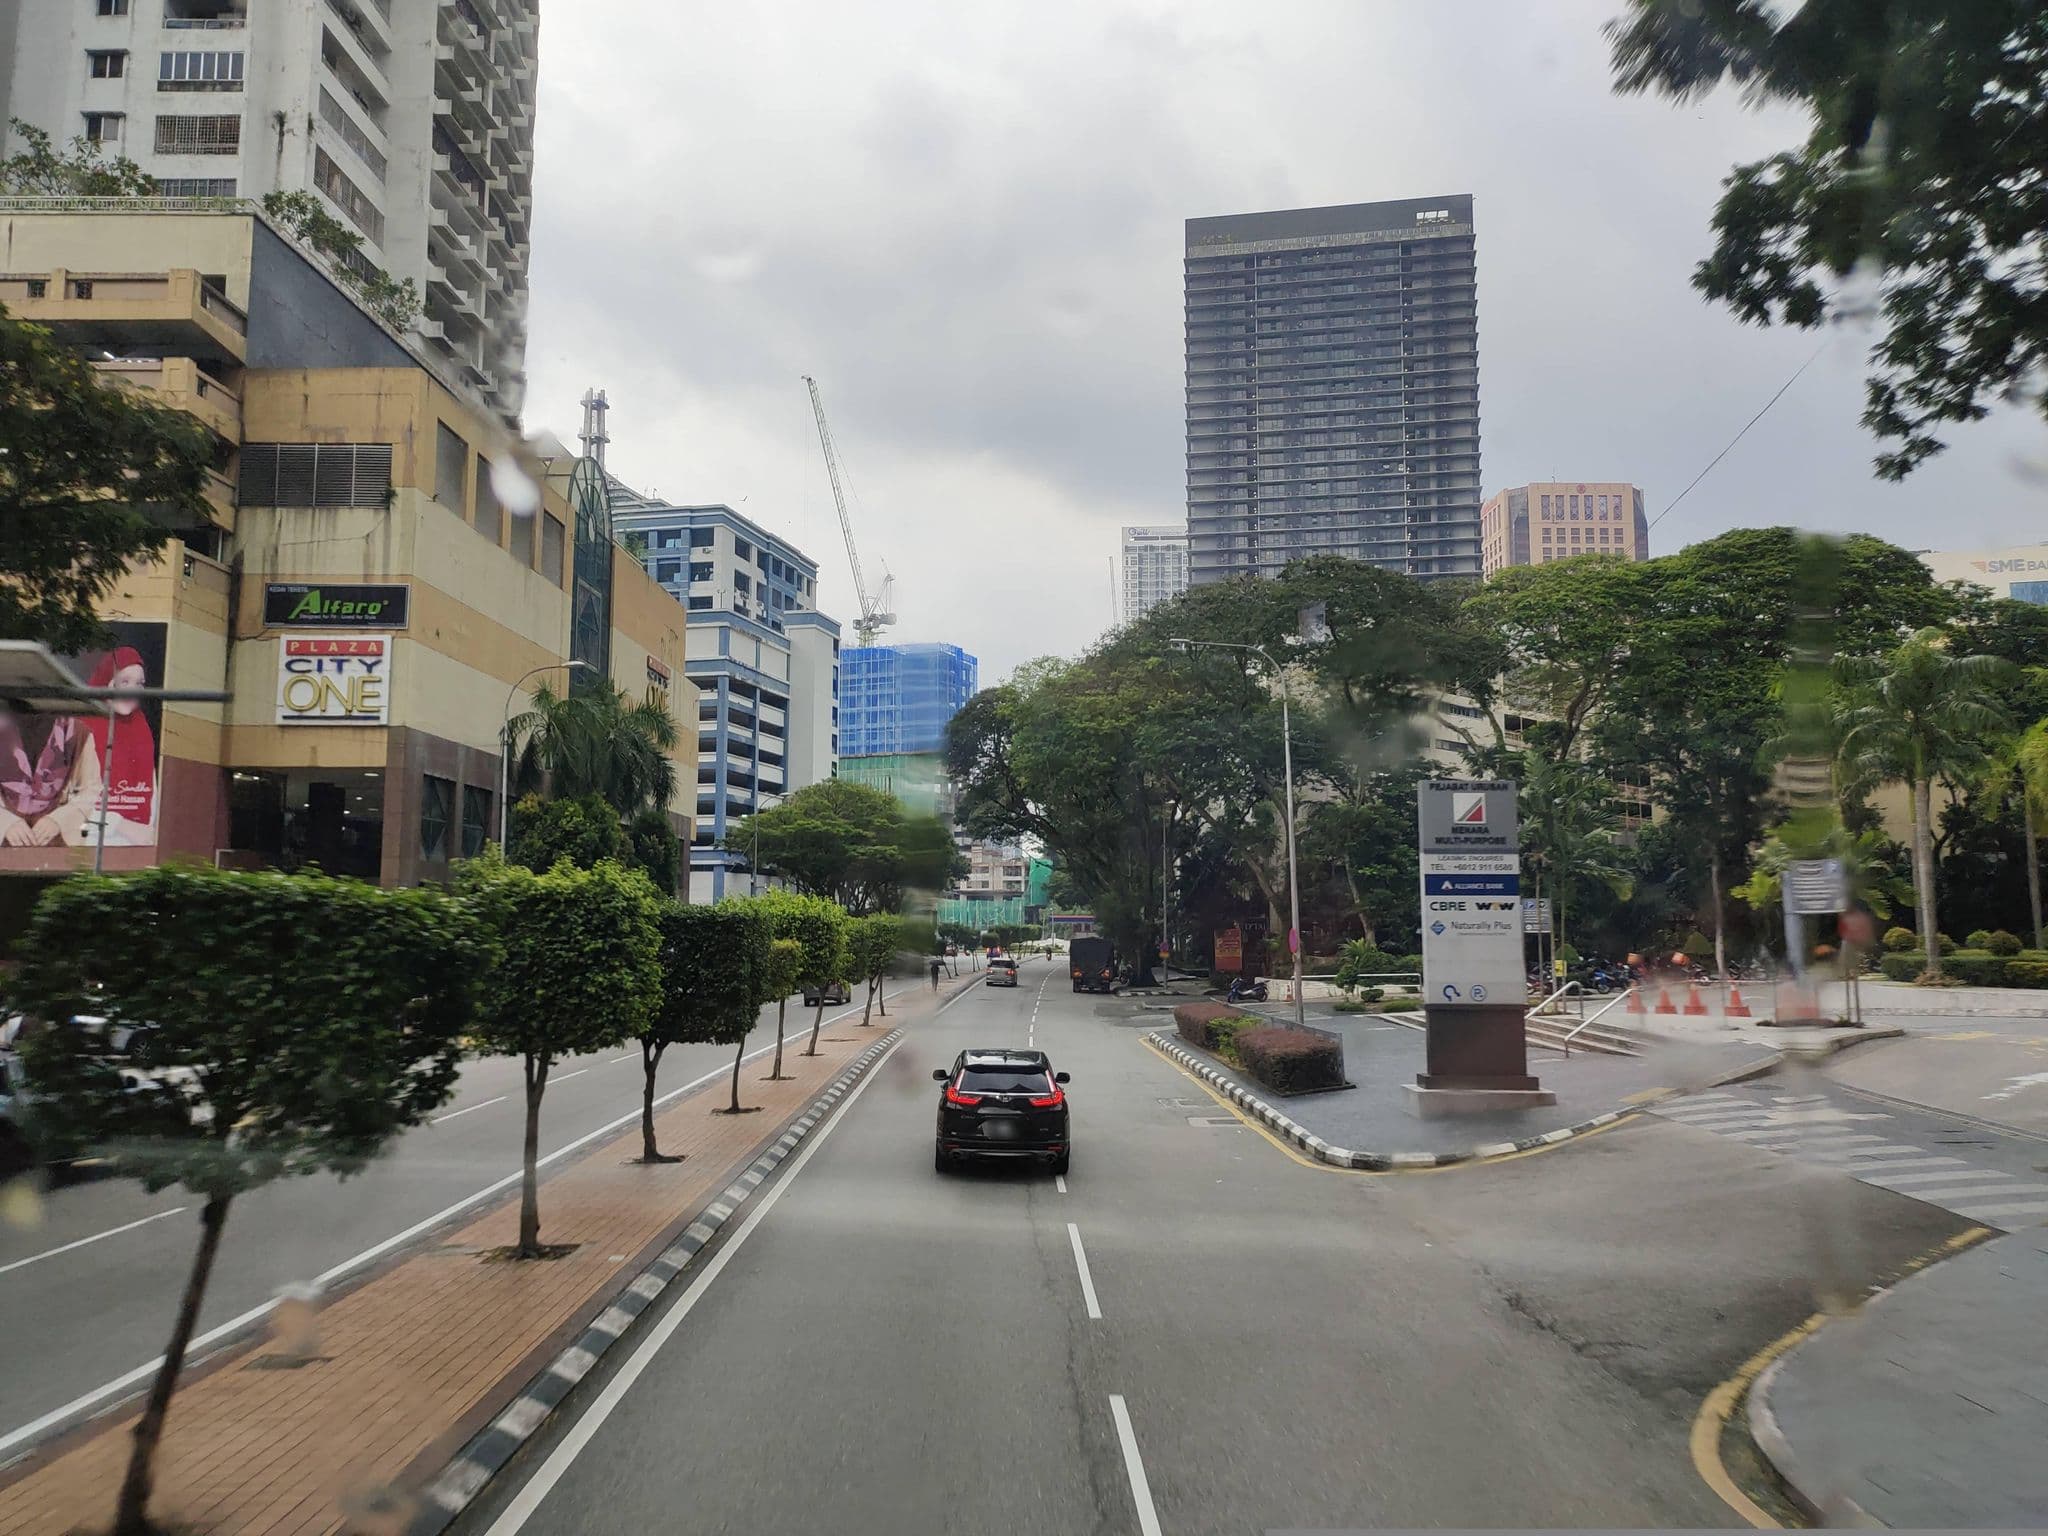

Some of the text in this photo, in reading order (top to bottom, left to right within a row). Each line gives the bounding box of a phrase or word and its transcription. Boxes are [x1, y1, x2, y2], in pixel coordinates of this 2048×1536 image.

[1988, 559, 2048, 573] SME BA
[287, 589, 382, 619] Alfaro
[290, 642, 378, 652] PLAZA
[285, 658, 382, 673] CITY
[283, 675, 383, 712] ONE
[1430, 902, 1467, 911] CBRE
[1451, 921, 1512, 930] Naturally Plus
